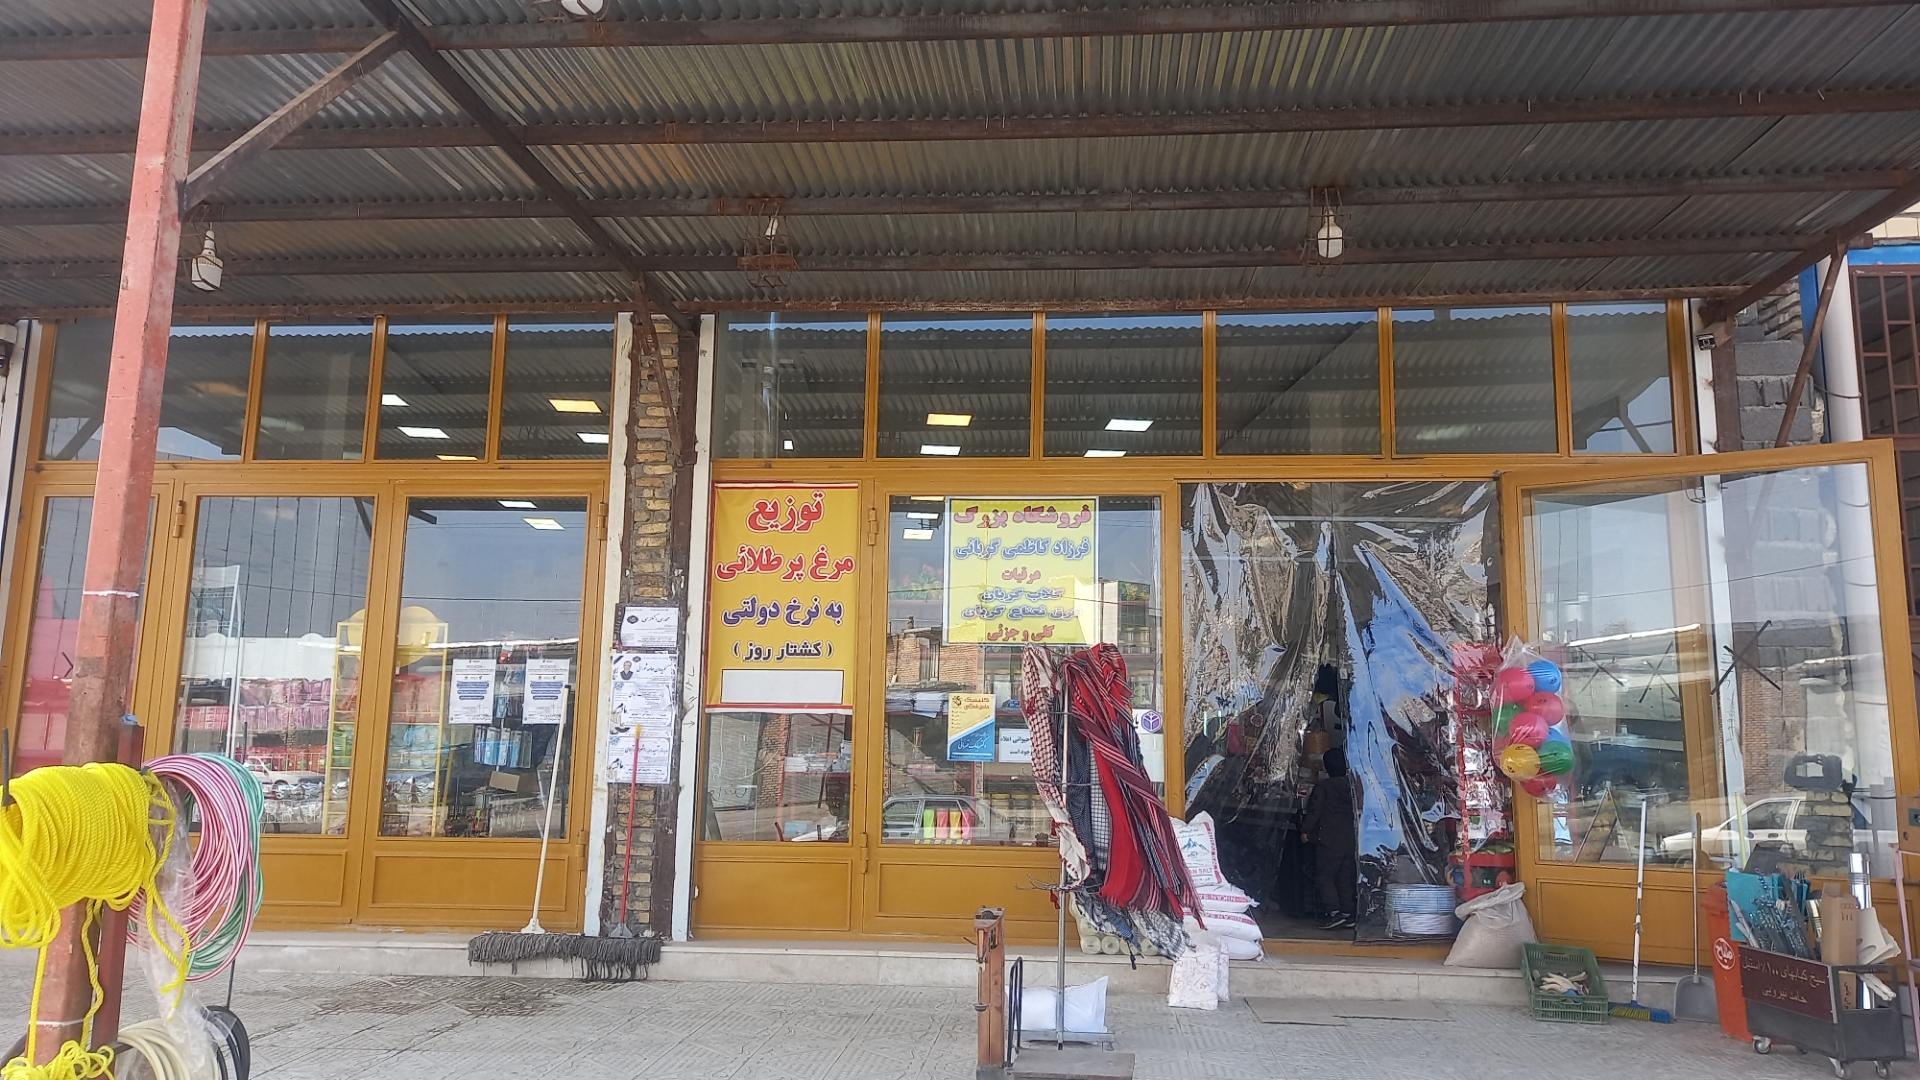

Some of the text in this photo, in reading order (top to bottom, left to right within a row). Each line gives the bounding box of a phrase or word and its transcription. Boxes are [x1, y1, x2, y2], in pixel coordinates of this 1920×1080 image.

[747, 491, 825, 532] توزیع
[954, 505, 1092, 528] فروشگاه بزرگ
[1002, 537, 1051, 560] کاظمی
[1052, 538, 1091, 560] فرزاد
[809, 545, 855, 581] مرغ
[722, 595, 843, 625] به نرخ دولتی
[1021, 629, 1029, 641] و
[1808, 973, 1826, 988] سیخ
